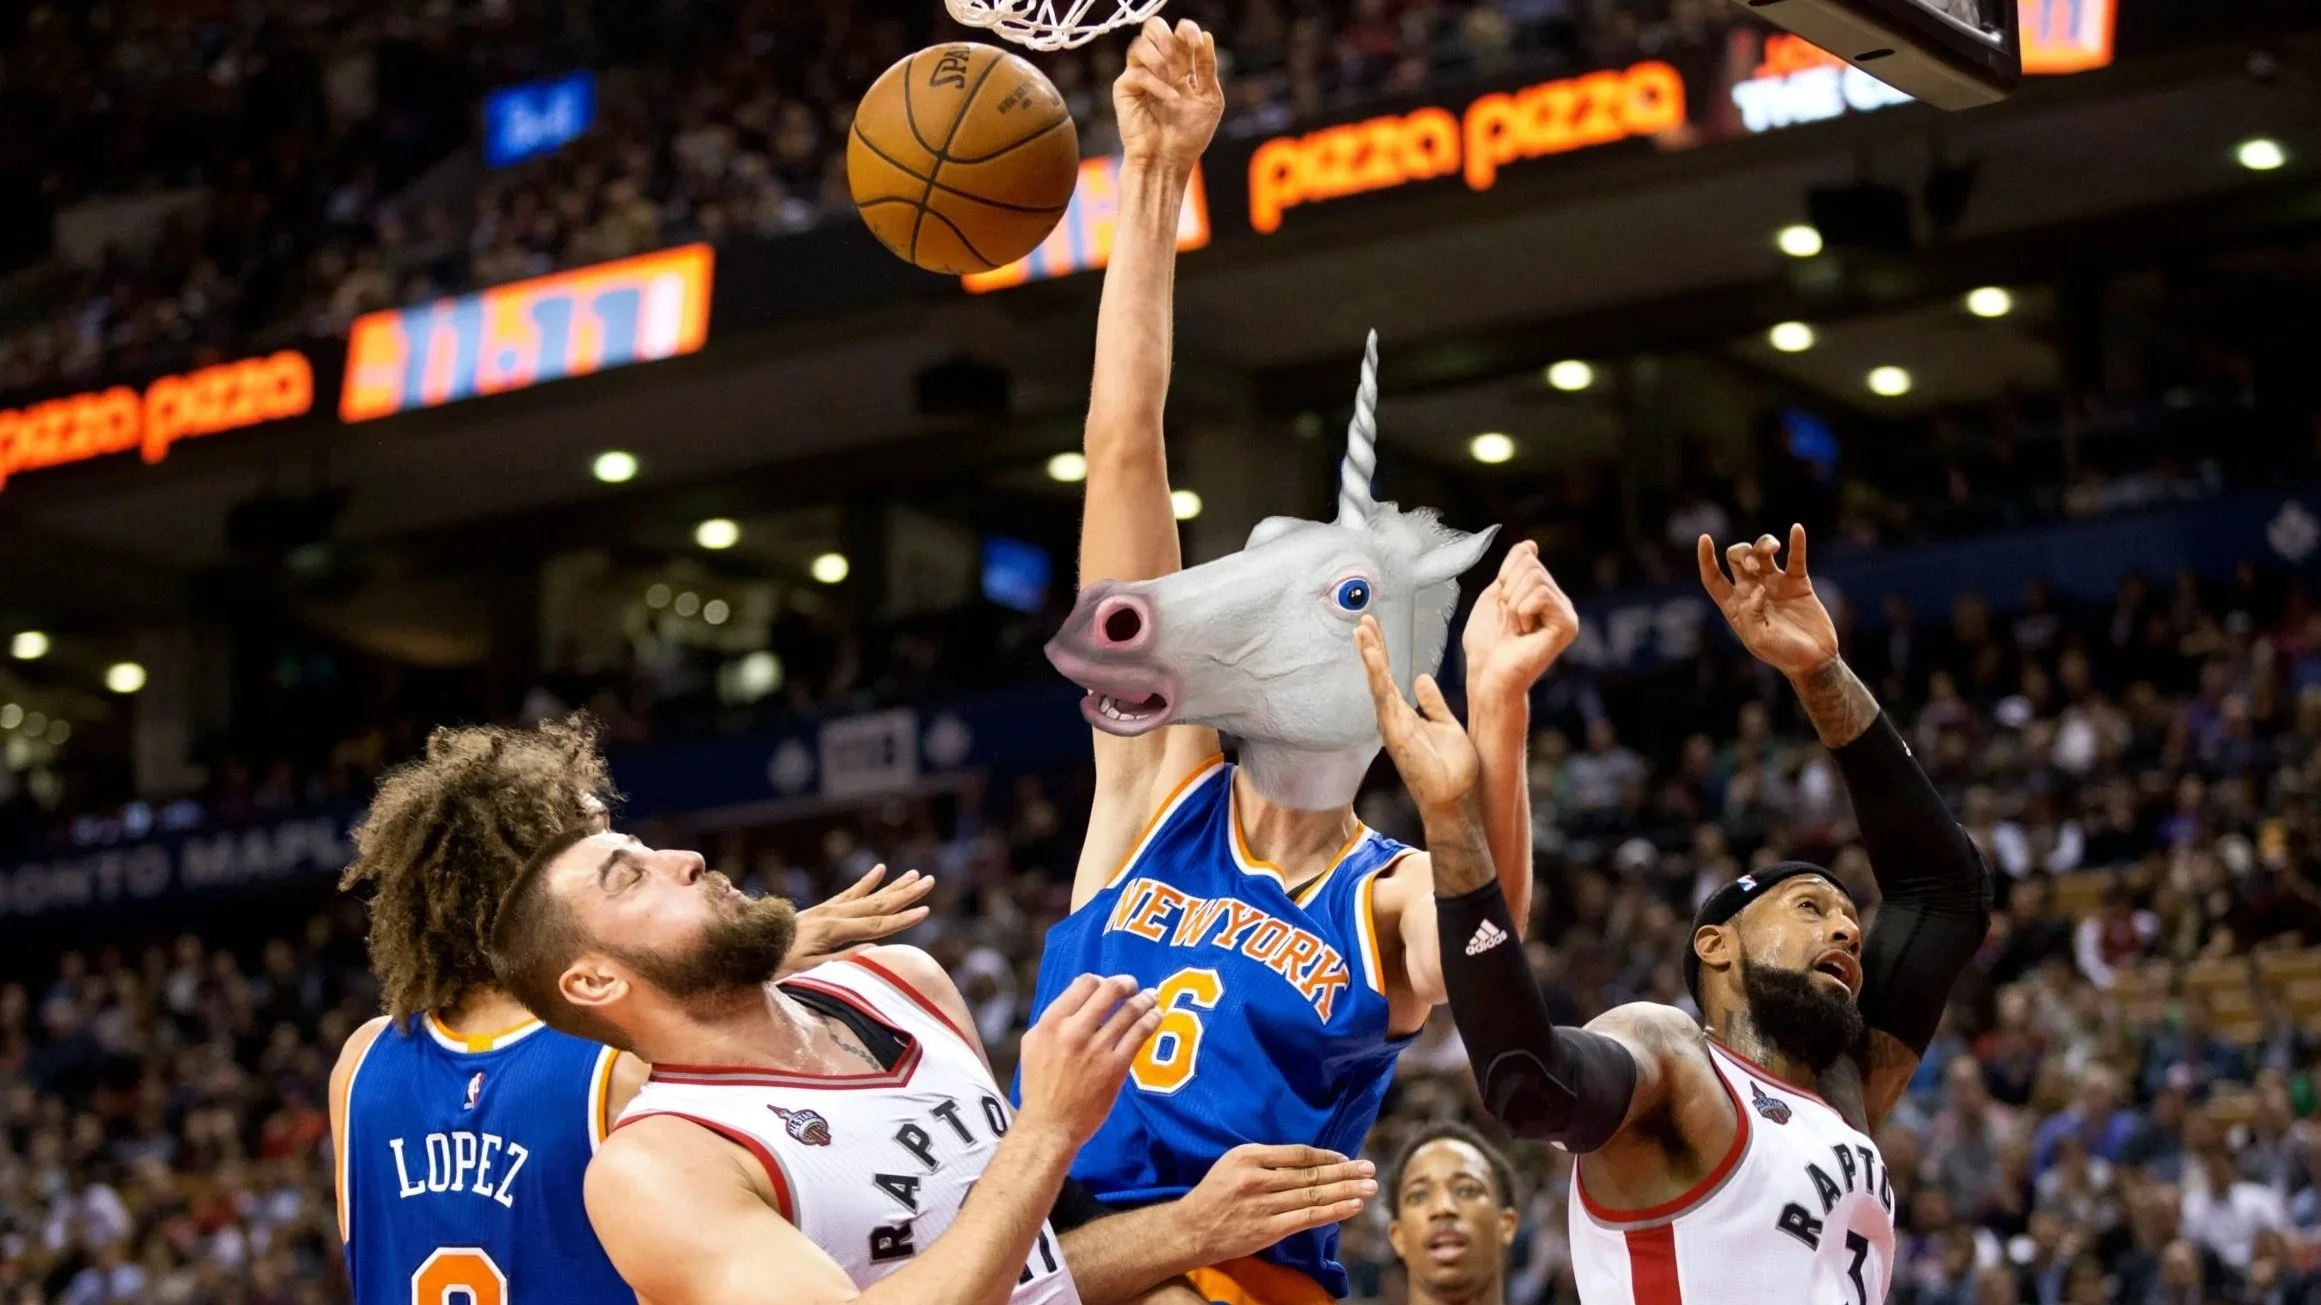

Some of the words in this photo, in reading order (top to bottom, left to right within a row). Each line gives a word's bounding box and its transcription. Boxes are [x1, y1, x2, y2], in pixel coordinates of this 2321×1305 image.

[1249, 107, 1461, 235] pizza
[1464, 61, 1686, 191] pizza
[141, 350, 314, 464] pizza
[1465, 930, 1508, 956] adidas
[389, 1131, 529, 1208] LOPEZ
